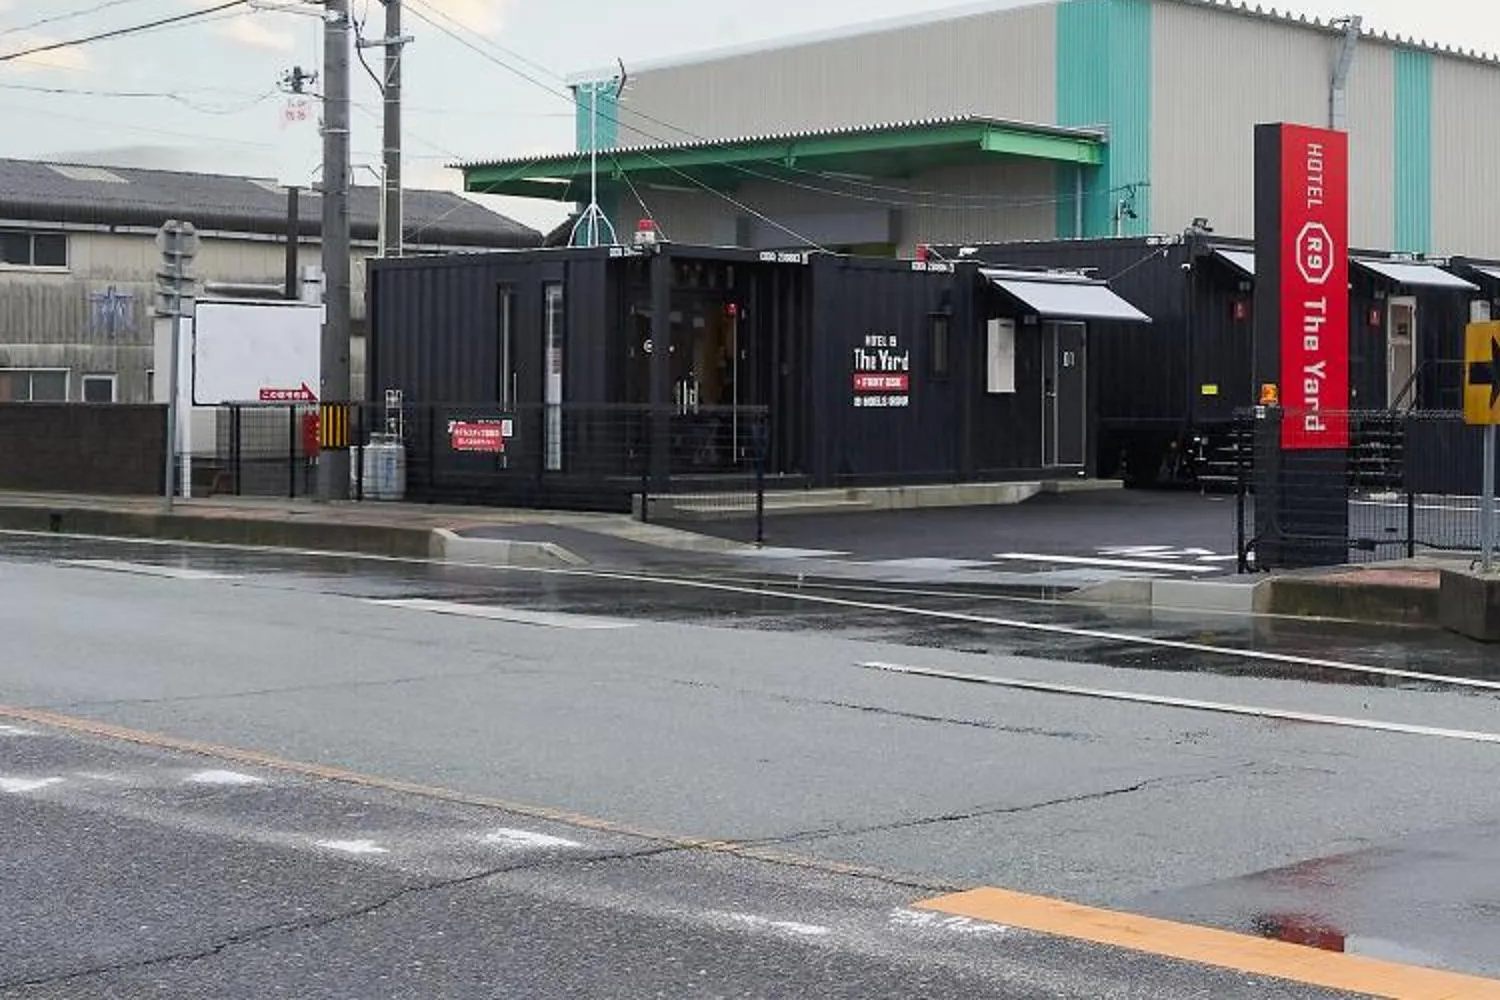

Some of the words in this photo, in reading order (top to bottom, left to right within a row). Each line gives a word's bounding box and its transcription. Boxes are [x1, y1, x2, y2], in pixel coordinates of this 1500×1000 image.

[1307, 143, 1323, 209] HOTEL
[1307, 237, 1322, 269] R9
[1304, 296, 1326, 350] The
[854, 348, 876, 371] The
[878, 349, 909, 371] Yard
[1304, 360, 1326, 431] Yard
